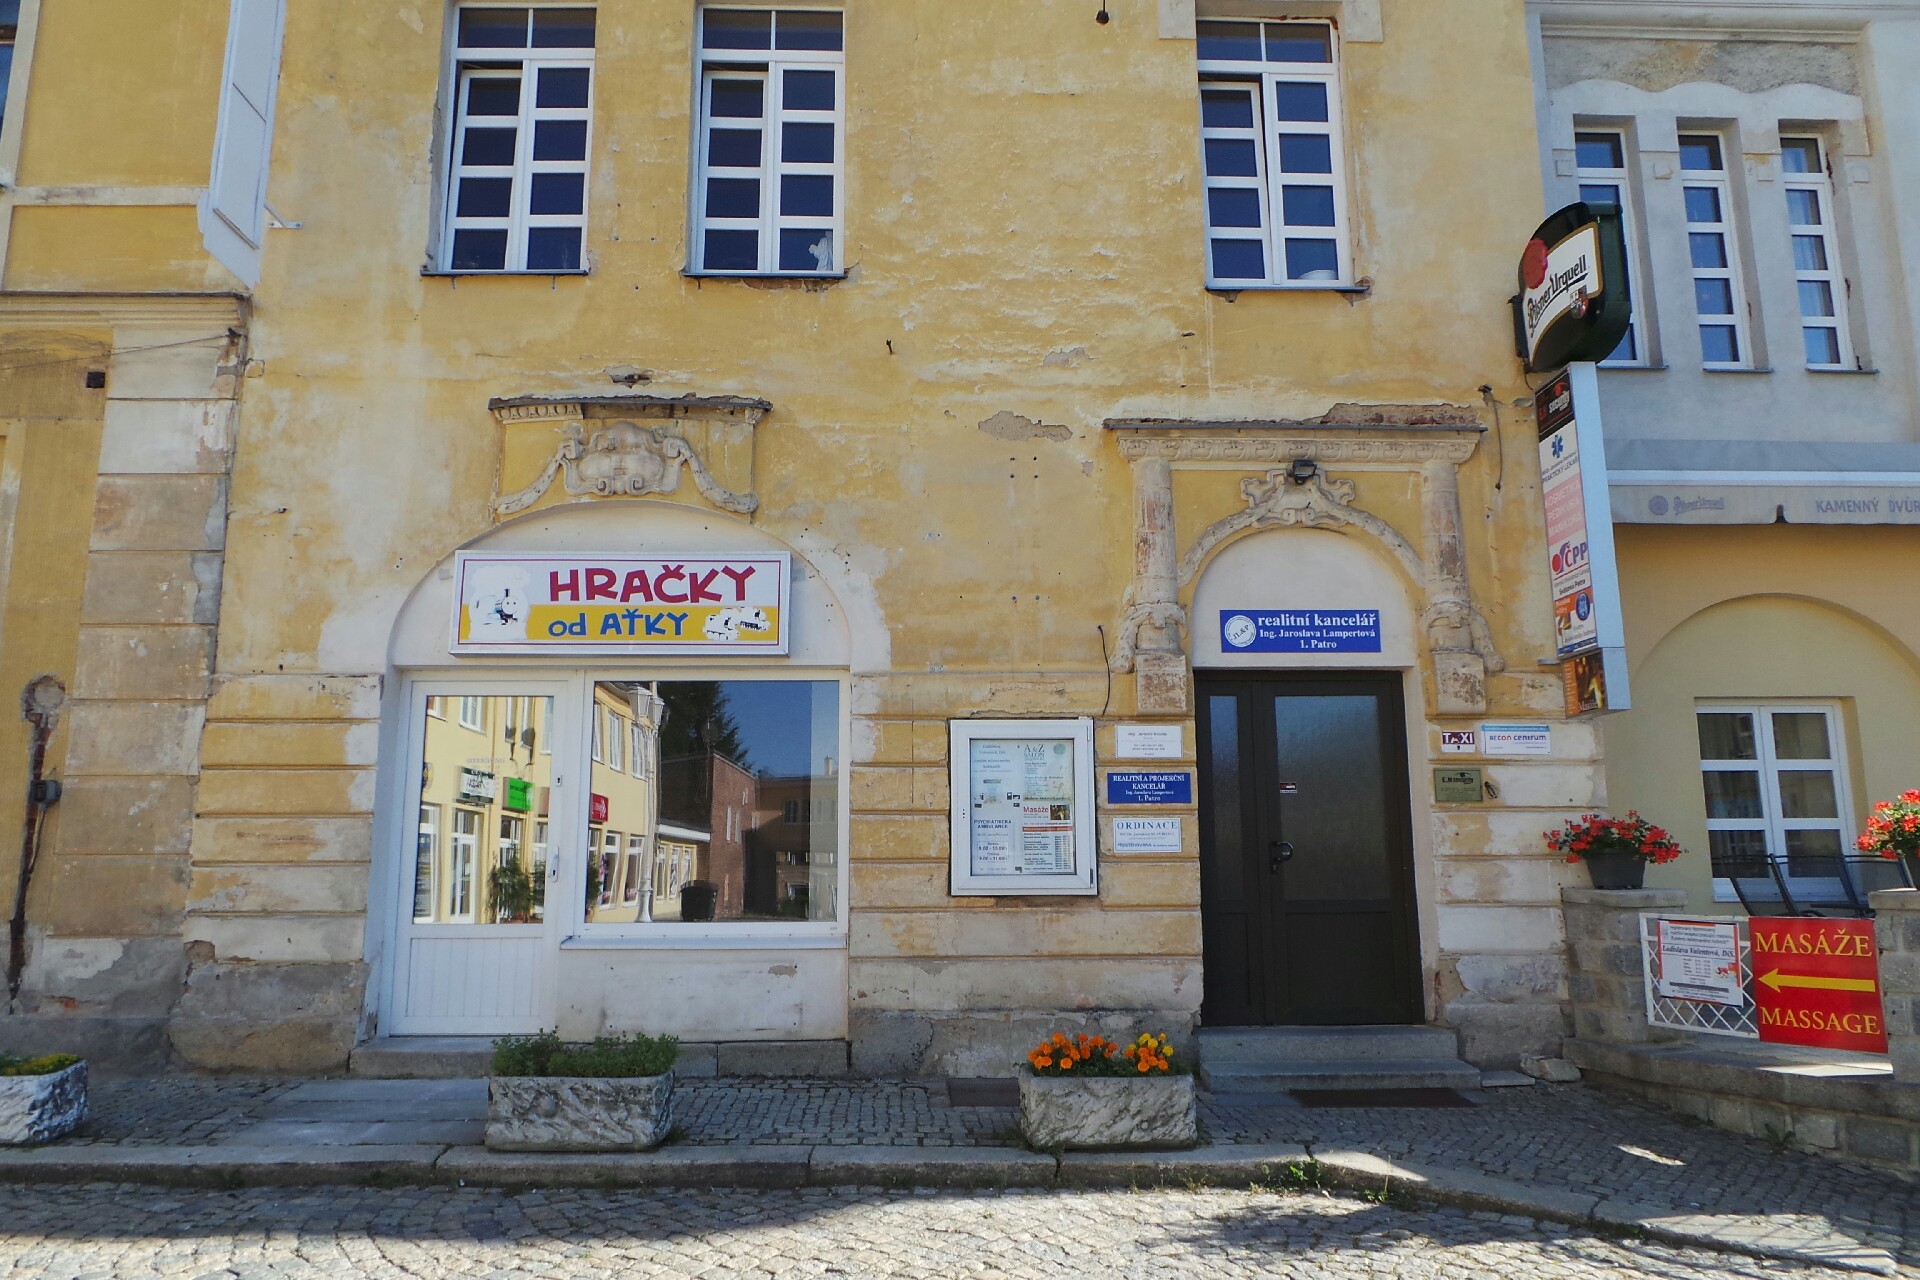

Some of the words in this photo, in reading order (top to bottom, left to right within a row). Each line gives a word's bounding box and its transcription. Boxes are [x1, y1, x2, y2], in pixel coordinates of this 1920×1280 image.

[1527, 285, 1552, 338] Pilsner
[1550, 254, 1587, 294] Urquell
[1816, 497, 1879, 512] KAMENNÝ
[1565, 542, 1587, 567] ČPP
[549, 564, 756, 604] HRAČKY
[548, 612, 587, 637] od
[600, 609, 689, 636] AŤKY
[1258, 613, 1310, 626] realitní
[1314, 613, 1377, 626] kancelář
[1260, 629, 1277, 639] Ing.
[1279, 629, 1321, 638] Jaroslava
[1323, 629, 1376, 639] Lampertová
[1300, 640, 1308, 649] 1.
[1311, 640, 1337, 649] Patro
[1442, 732, 1473, 744] TAXI
[1113, 774, 1143, 782] REALITNÍ
[1149, 774, 1185, 782] PROJEKČNÍ
[1132, 782, 1166, 790] KANCELÁŘ
[1117, 821, 1178, 829] ORDINACE
[1755, 928, 1873, 957] MASÁŽE
[1760, 1006, 1881, 1035] MASSAGE
